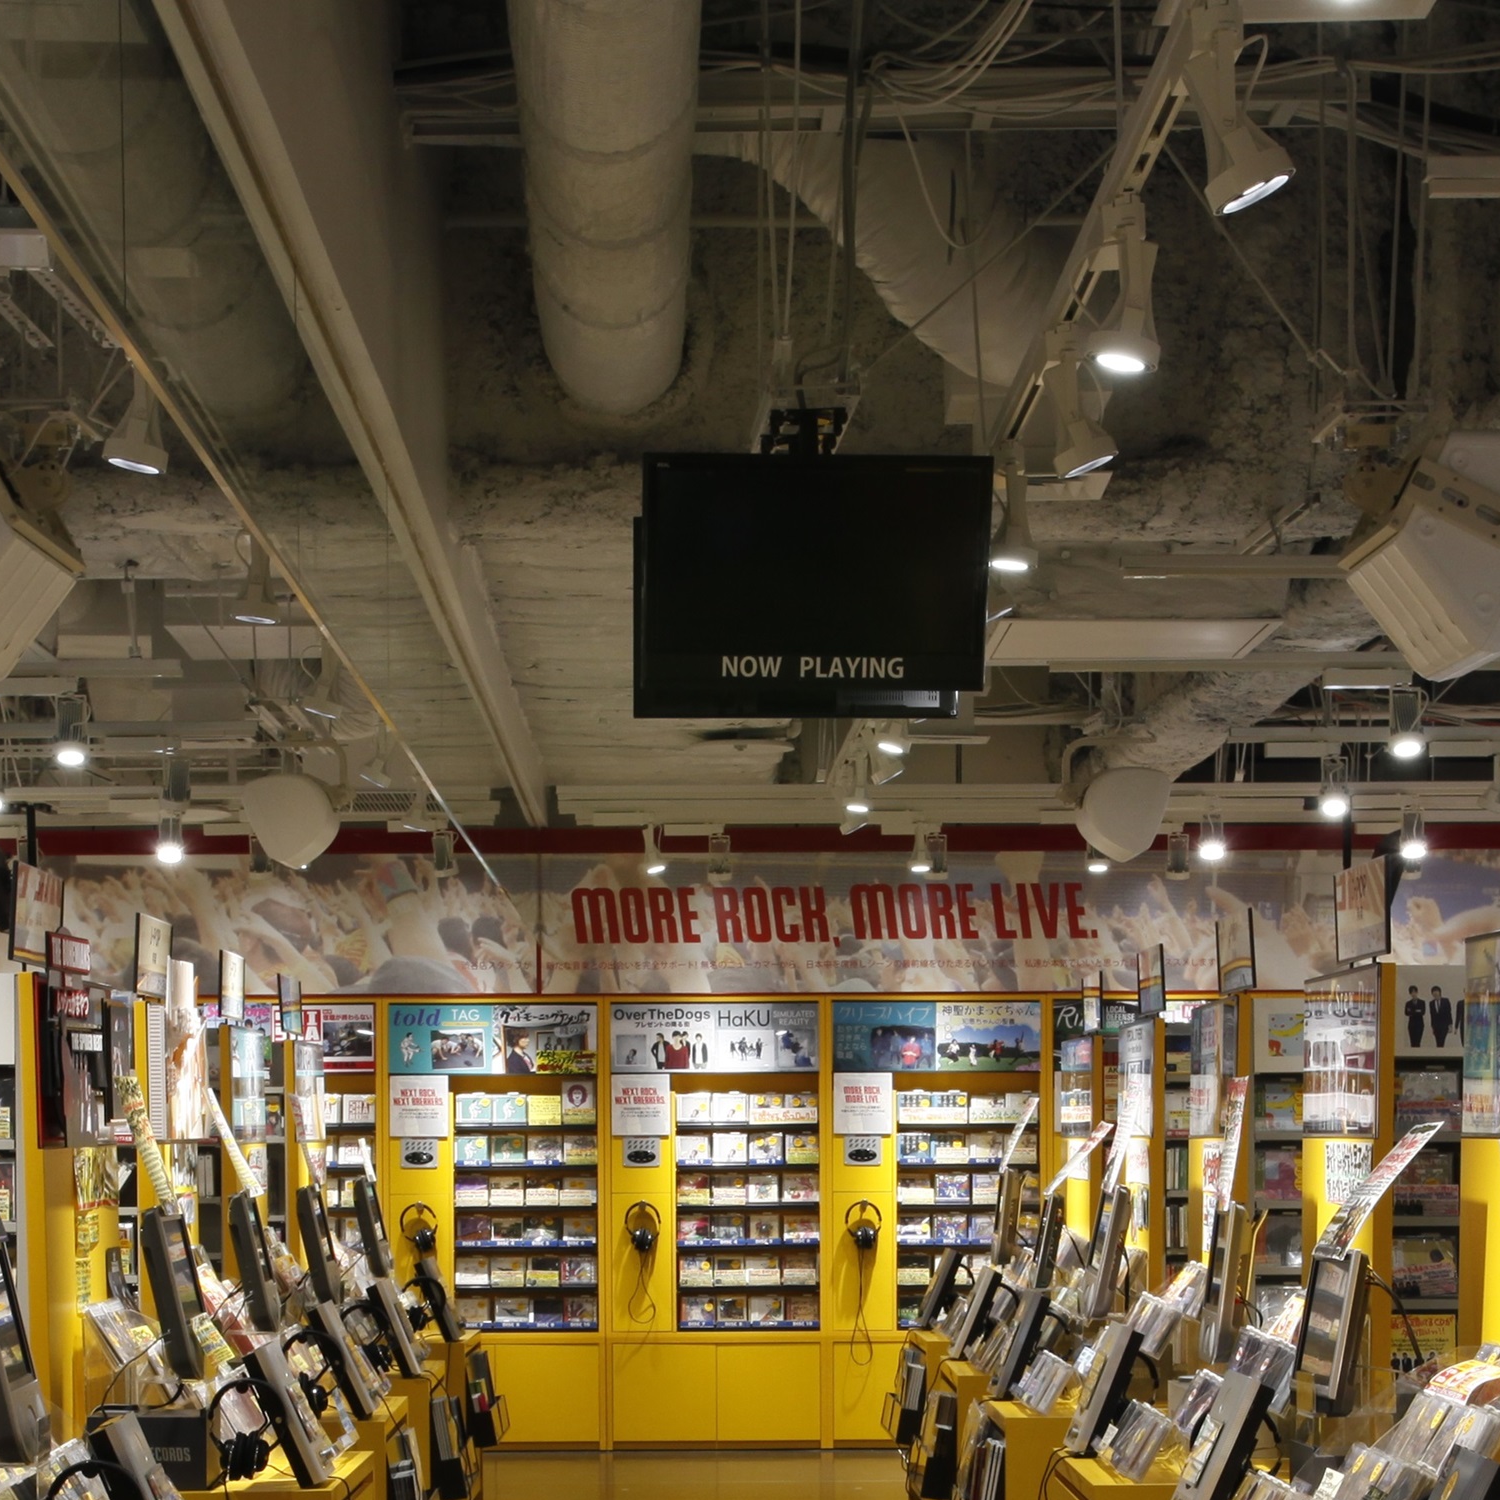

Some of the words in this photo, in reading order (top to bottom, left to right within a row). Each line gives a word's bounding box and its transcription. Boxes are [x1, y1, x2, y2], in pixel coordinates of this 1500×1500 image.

[721, 656, 782, 678] NOW
[800, 656, 905, 679] PLAYING
[572, 886, 701, 945] MORE
[715, 887, 841, 948] ROCK,
[852, 884, 977, 941] MORE
[993, 881, 1100, 940] LIVE.
[773, 1009, 816, 1018] SIMULATED
[941, 1003, 1036, 1017] 神聖かまってちゃん
[1105, 1005, 1126, 1013] LOCAL
[392, 1006, 442, 1028] told
[451, 1008, 481, 1022] TAG
[613, 1008, 712, 1022] OverTheDogs
[718, 1008, 771, 1028] HaKU
[1105, 1013, 1136, 1021] DEFENSE
[778, 1018, 810, 1027] REALITY
[400, 1088, 419, 1097] NEXT
[621, 1088, 640, 1096] NEXT
[843, 1086, 861, 1095] MORE
[393, 1097, 413, 1106] NEXT
[615, 1096, 633, 1105] NEXT
[845, 1095, 861, 1103] MORE
